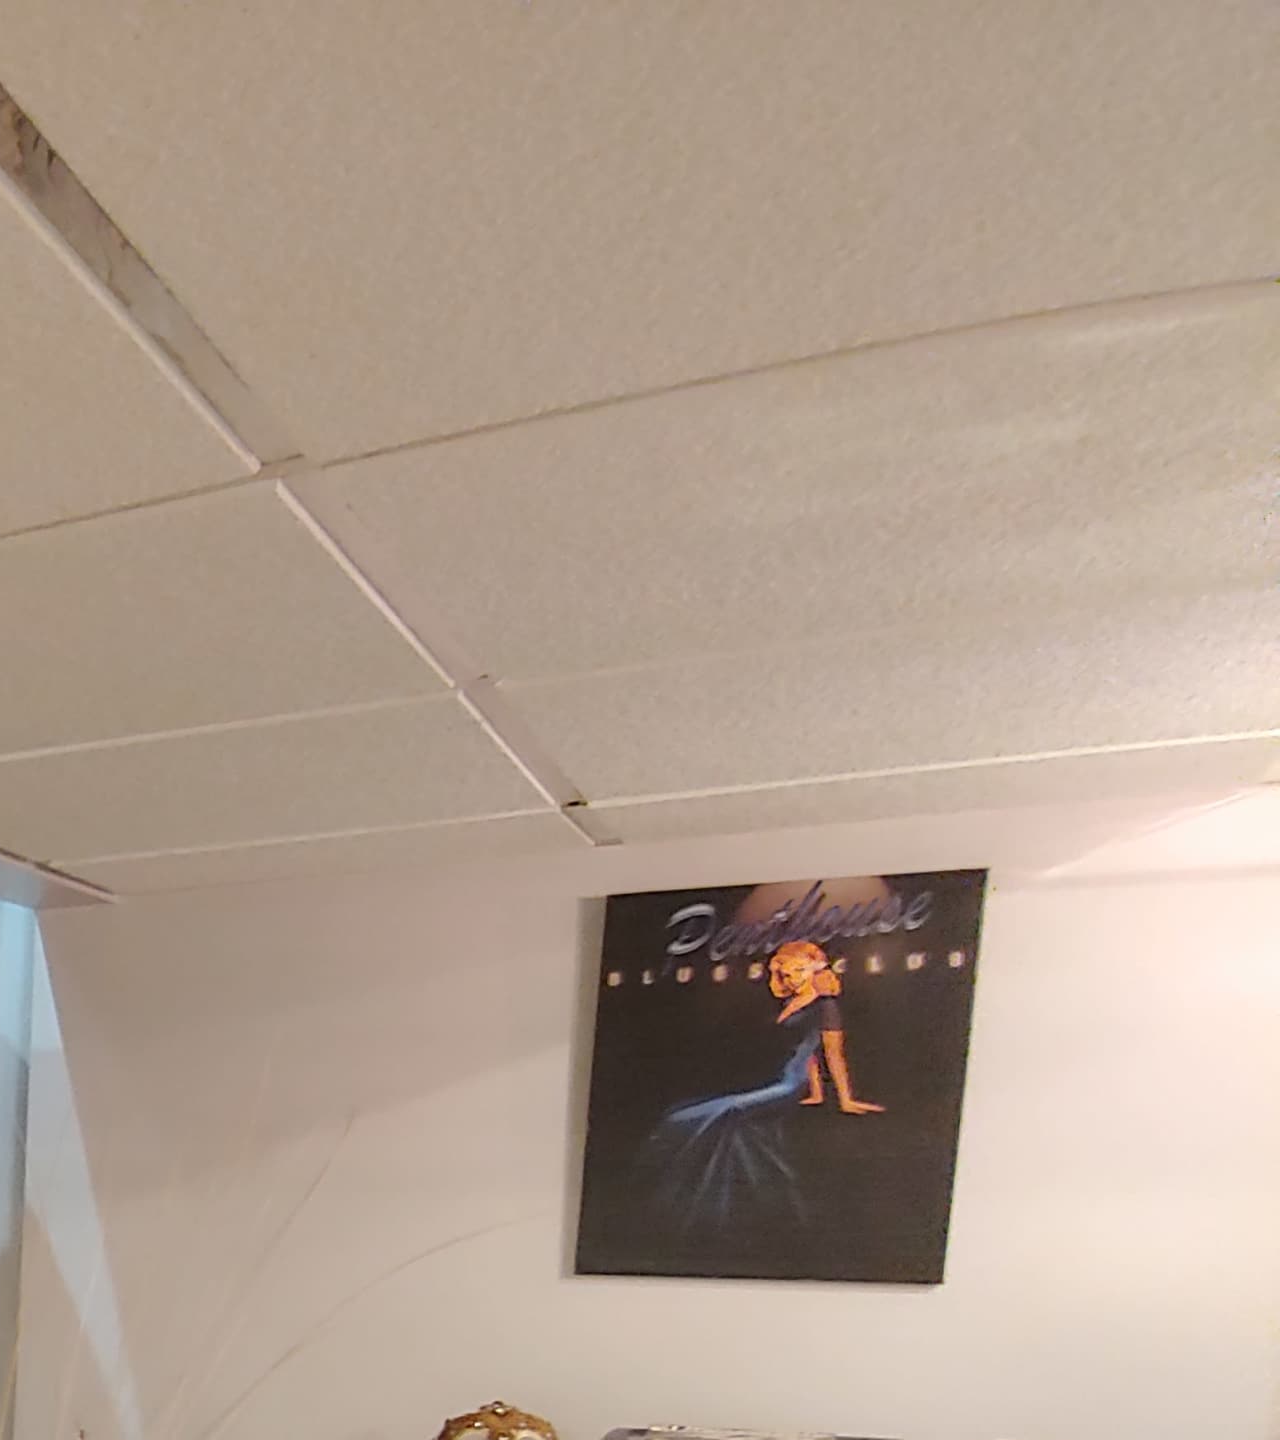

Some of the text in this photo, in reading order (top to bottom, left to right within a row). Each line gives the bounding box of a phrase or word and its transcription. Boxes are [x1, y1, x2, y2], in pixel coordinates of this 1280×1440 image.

[663, 880, 934, 975] Penthouse
[606, 950, 966, 987] BLUES CLUB
